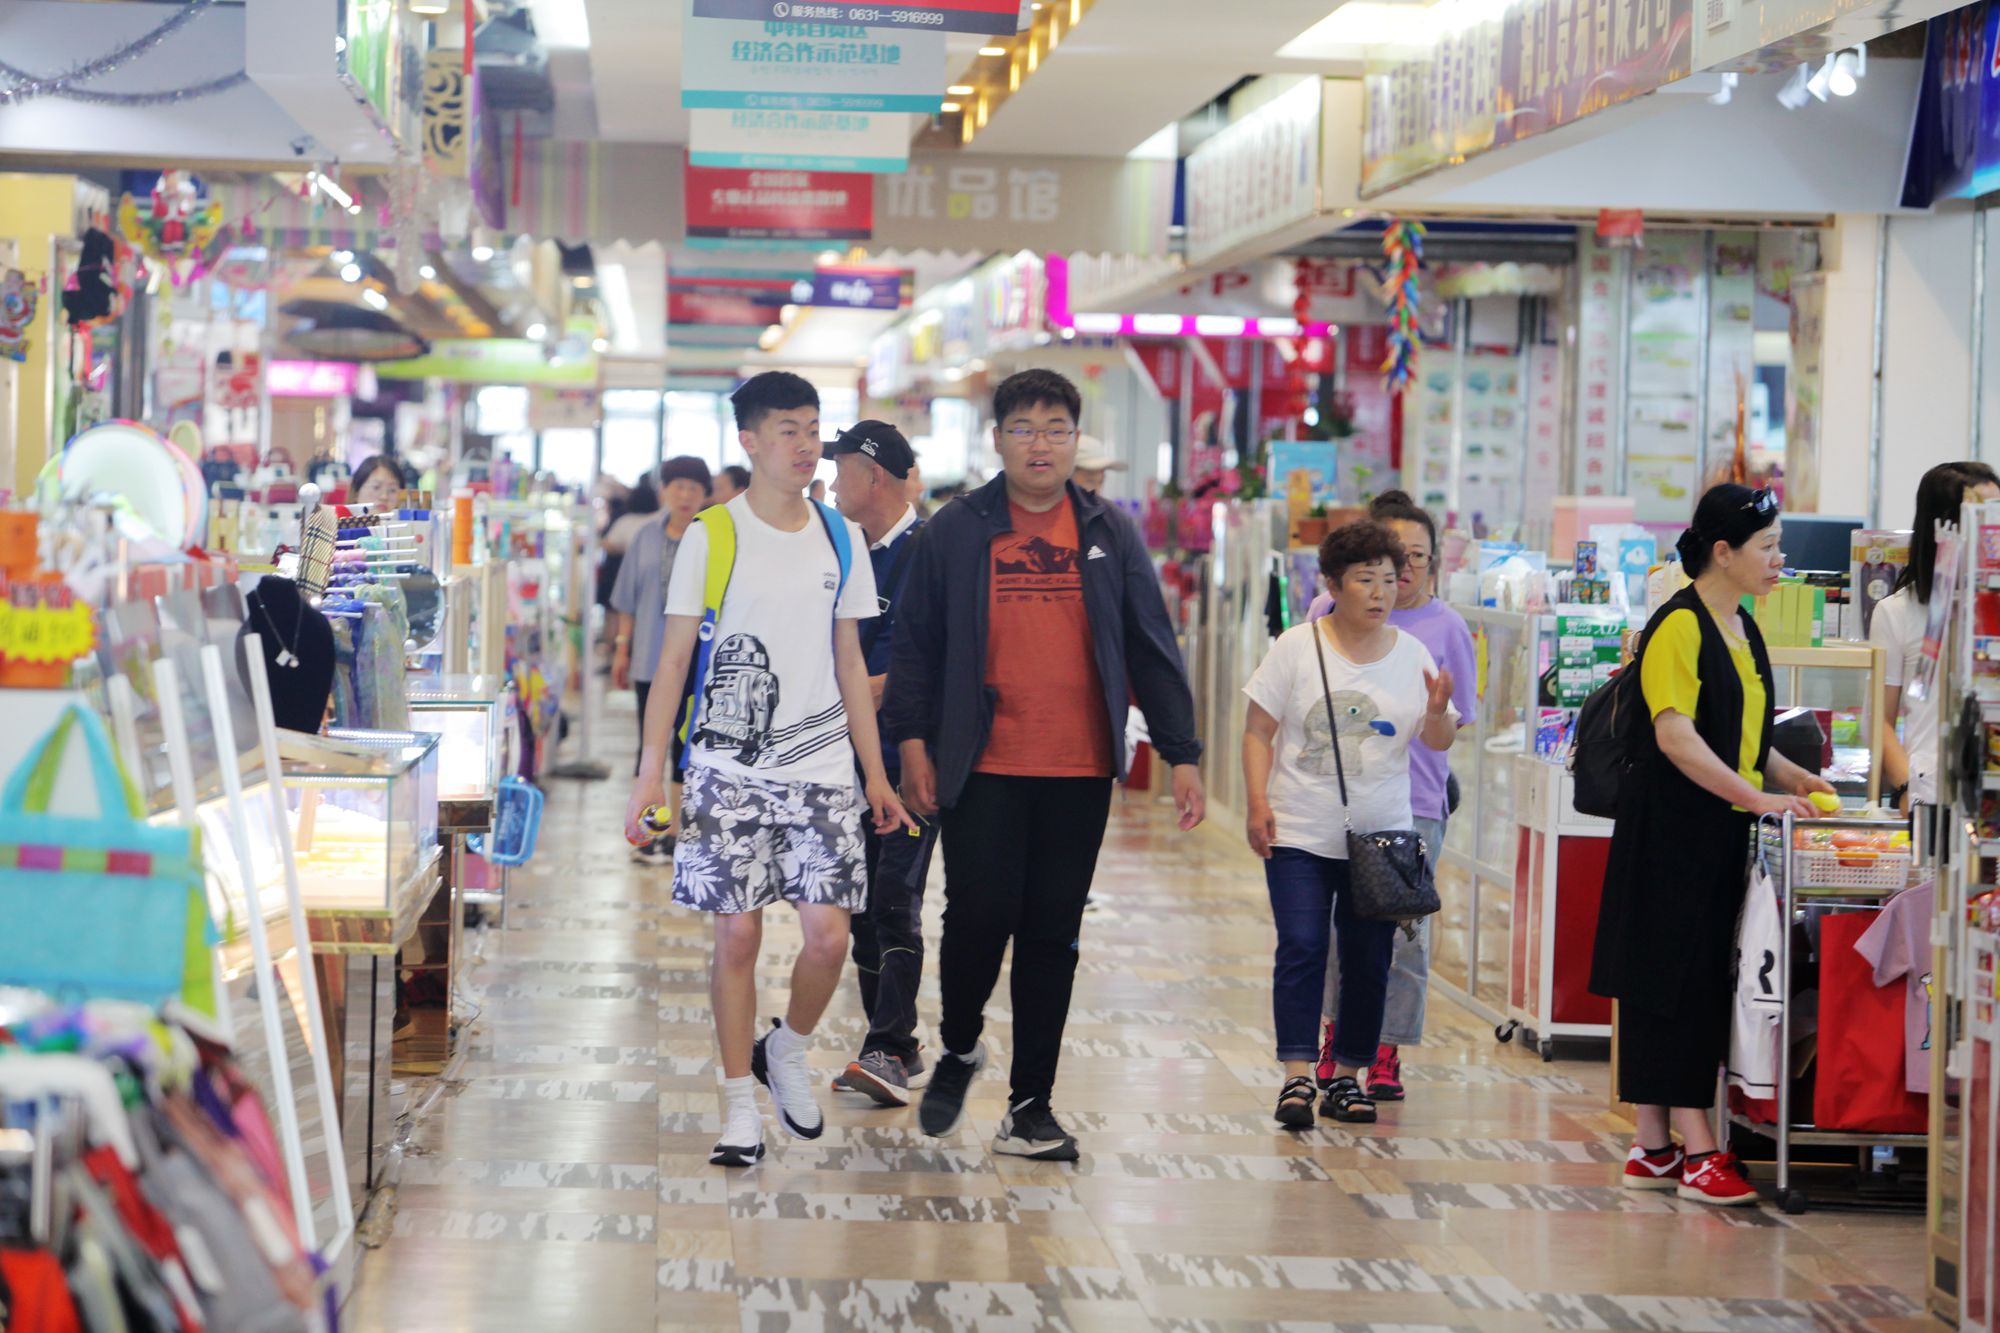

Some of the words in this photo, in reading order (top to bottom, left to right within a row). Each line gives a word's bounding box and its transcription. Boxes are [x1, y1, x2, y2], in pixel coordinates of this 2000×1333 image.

[848, 8, 945, 25] 0631—5916999
[731, 40, 902, 65] 经济合作示范基地
[883, 164, 1061, 222] 优品馆
